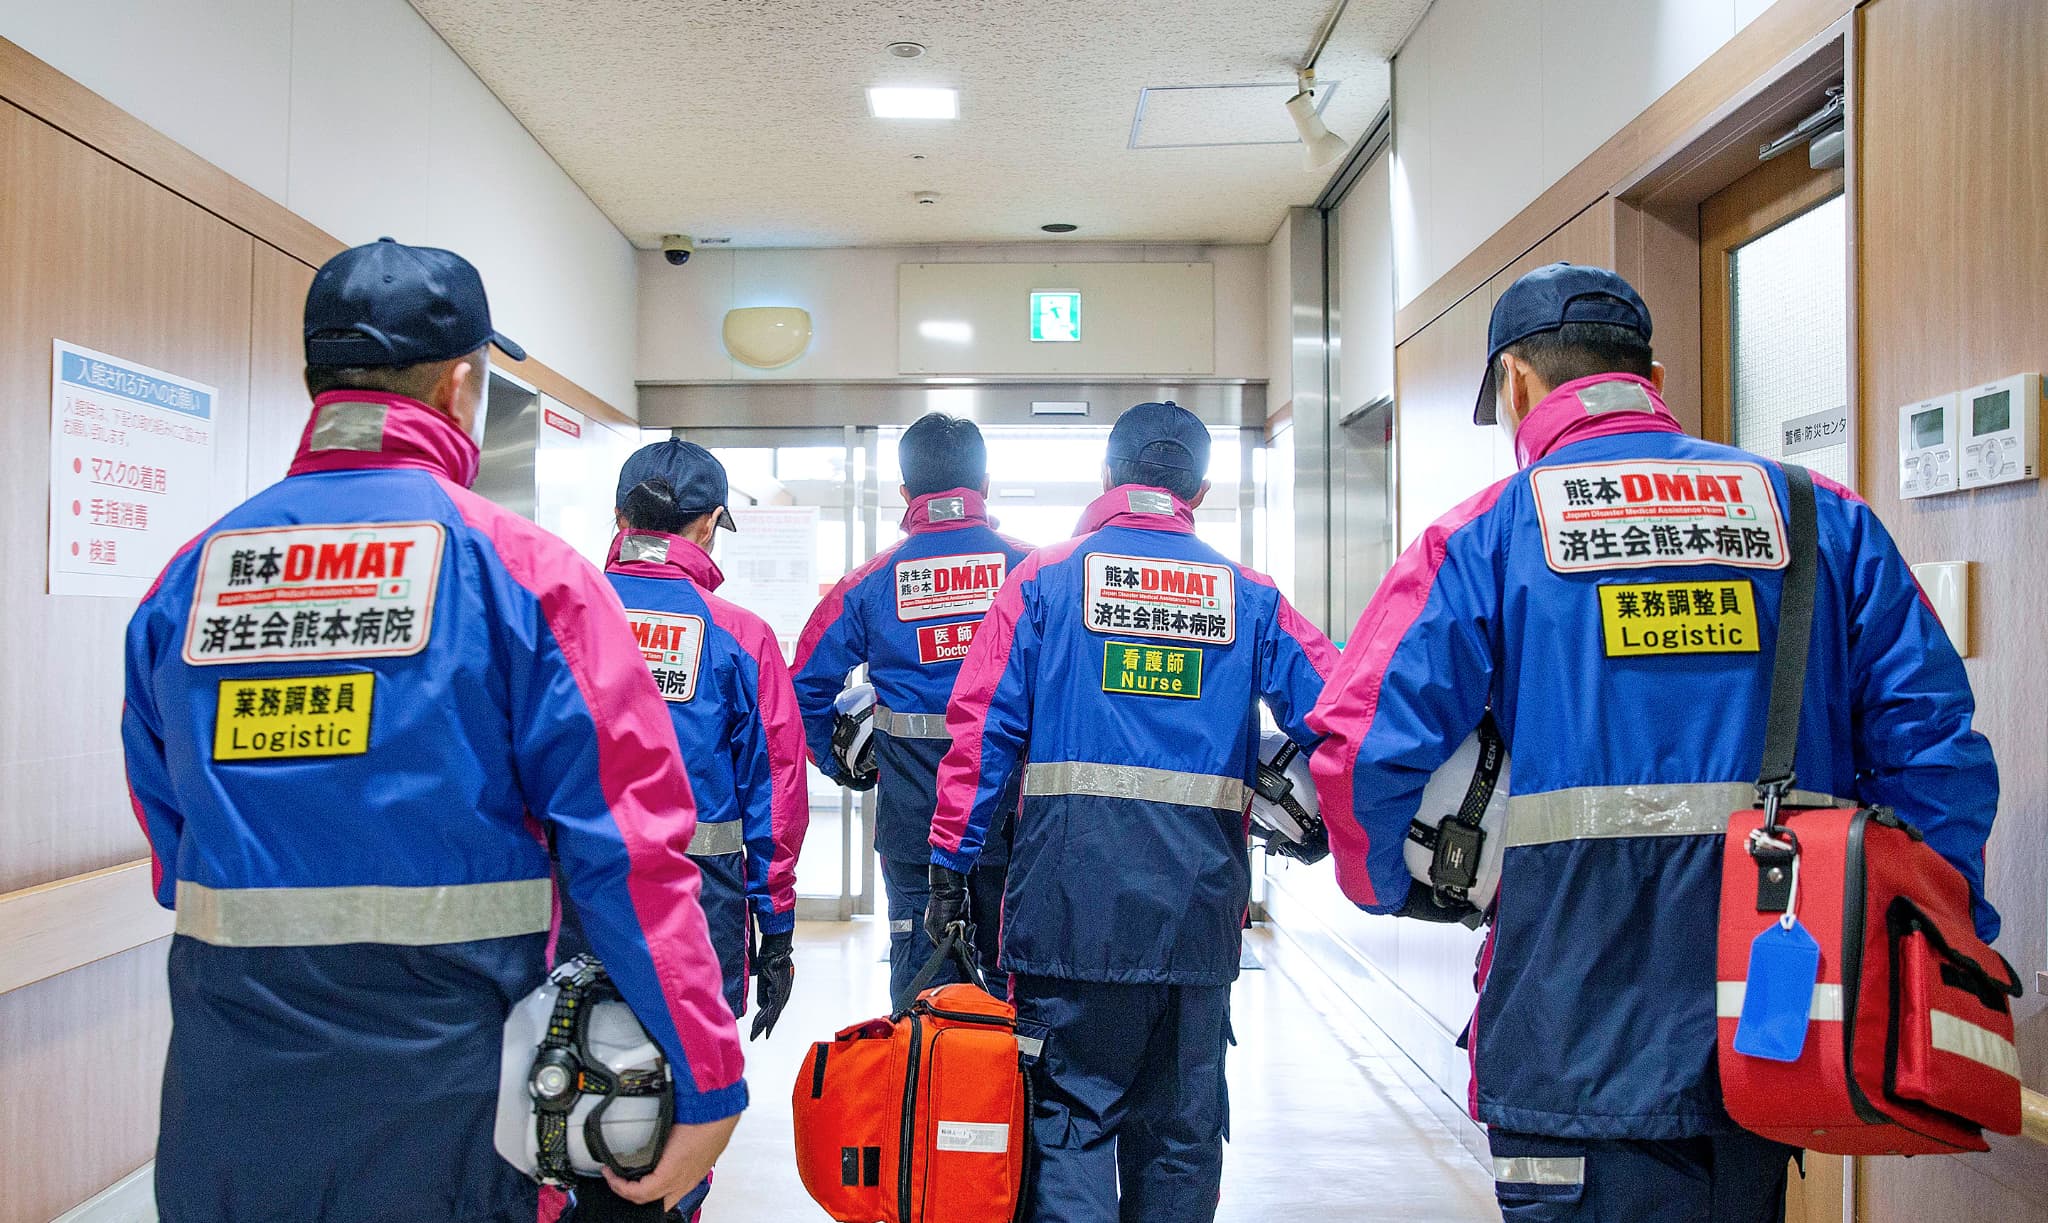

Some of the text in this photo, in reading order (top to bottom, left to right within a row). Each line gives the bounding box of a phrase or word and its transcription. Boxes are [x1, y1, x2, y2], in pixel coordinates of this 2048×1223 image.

[90, 457, 167, 492] マスクの着用
[89, 498, 149, 529] 手指消毒
[1565, 506, 1724, 520] Japan Disaster Medical Assistance Team
[89, 539, 117, 563] 検温
[1559, 524, 1774, 562] 済生会熊本病院
[899, 568, 932, 583] 済生会
[933, 563, 1002, 593] DMAT
[1616, 587, 1742, 619] 業務調整員
[200, 605, 416, 654] 済生会熊本病院
[934, 625, 973, 645] 医師
[1094, 602, 1226, 638] 済生会熊本病院
[629, 621, 687, 651] MAT
[1622, 623, 1743, 649] Logistic
[1122, 648, 1185, 674] 看護師
[1121, 671, 1183, 692] Nurse
[233, 682, 355, 719] 業務調整員
[232, 721, 352, 752] Logistic
